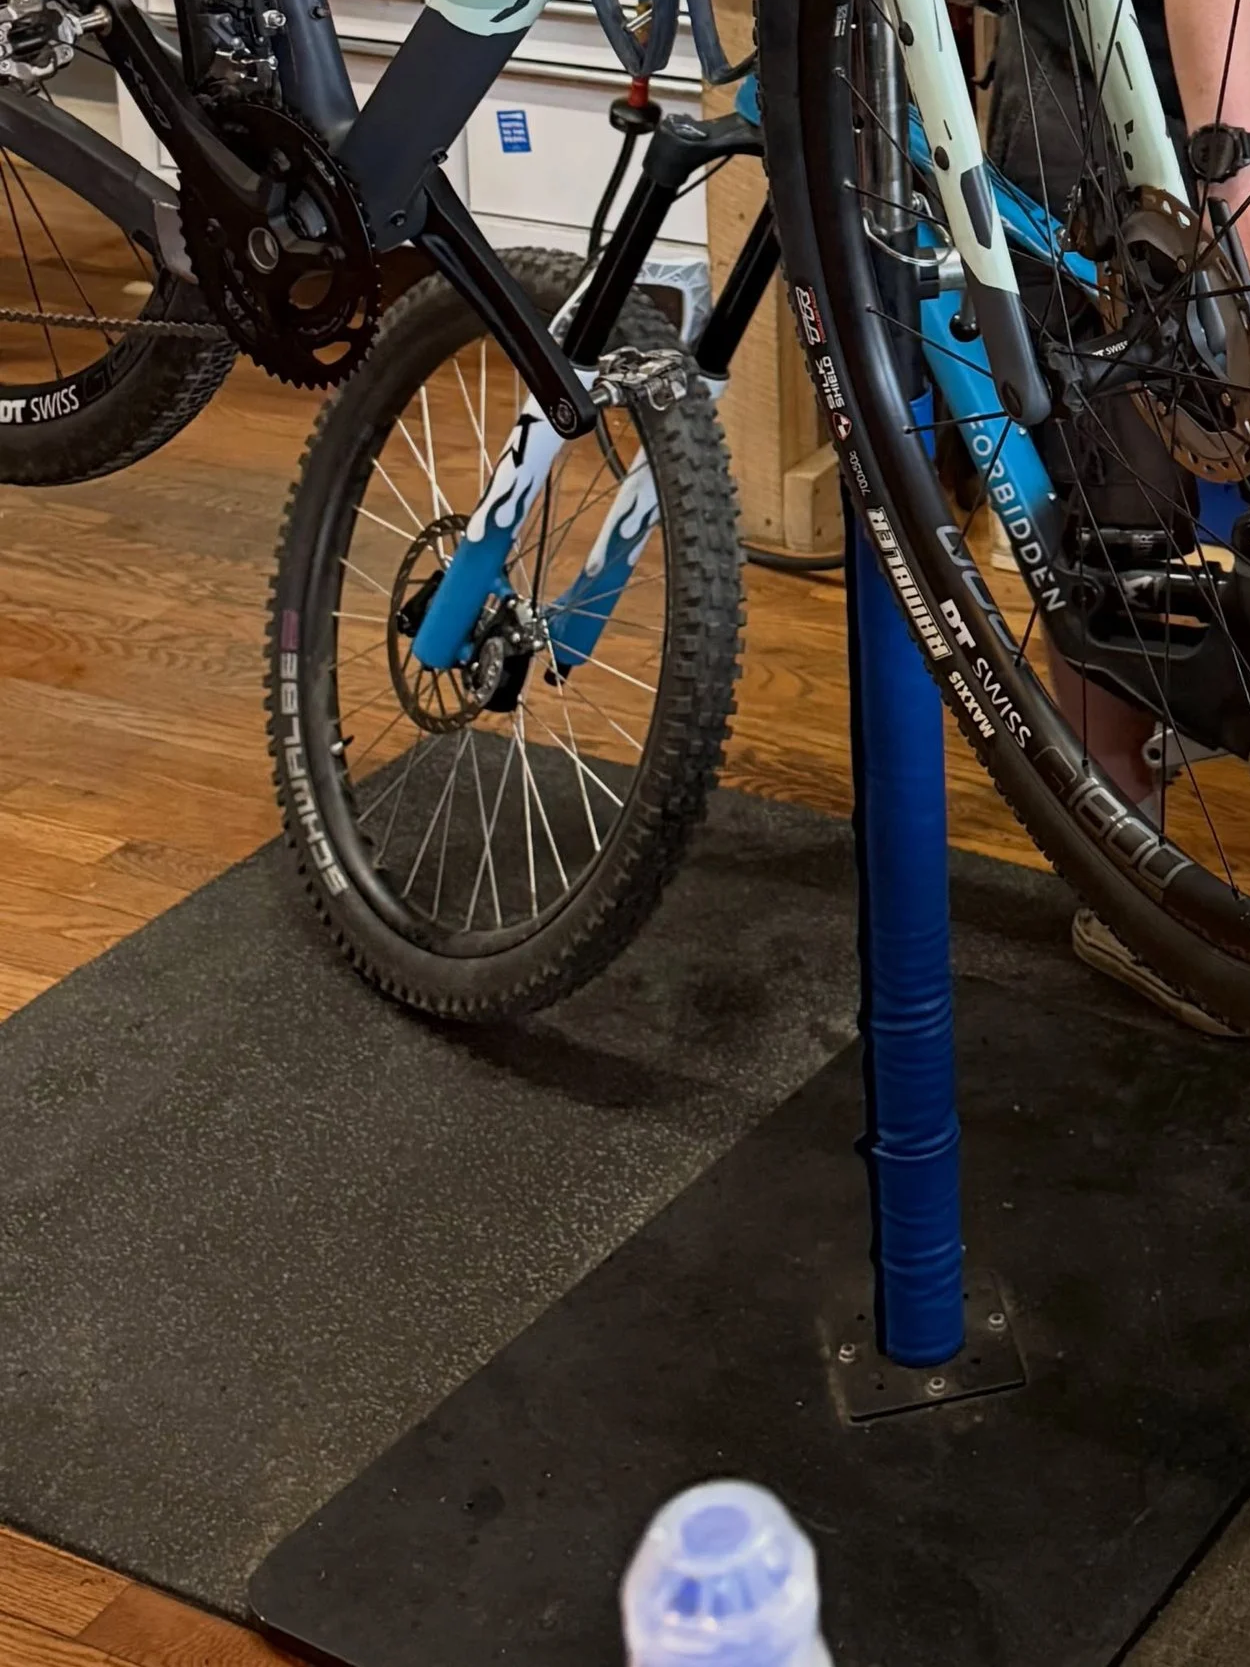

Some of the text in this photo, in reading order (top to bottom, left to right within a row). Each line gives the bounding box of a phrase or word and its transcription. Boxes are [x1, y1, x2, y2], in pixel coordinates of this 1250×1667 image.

[0, 384, 80, 424] DT SWISS
[866, 506, 954, 662] RAMBLER
[969, 412, 1067, 613] FORBIDDEN
[938, 598, 977, 650] DT
[971, 656, 1033, 750] SWISS
[948, 670, 996, 739] MAXXIS
[279, 652, 350, 897] SCHWALBE
